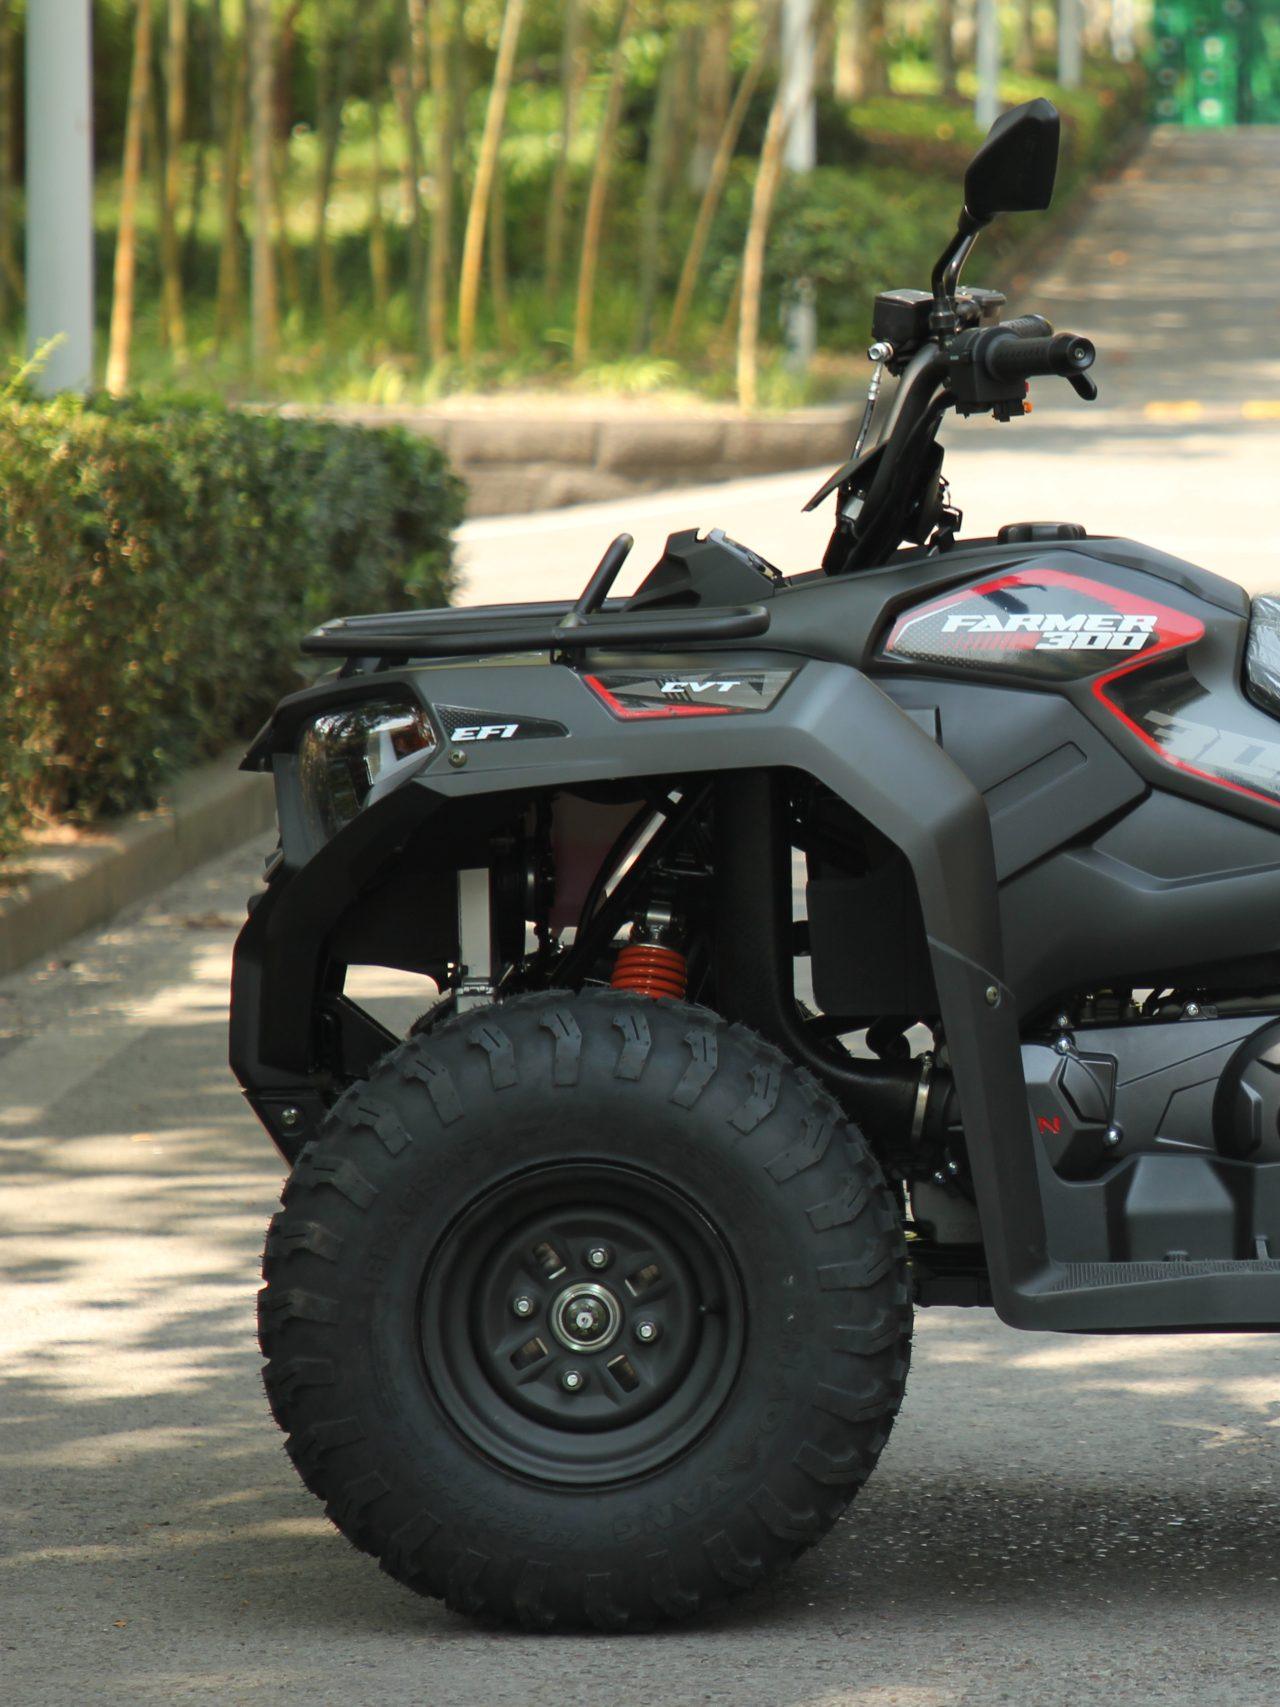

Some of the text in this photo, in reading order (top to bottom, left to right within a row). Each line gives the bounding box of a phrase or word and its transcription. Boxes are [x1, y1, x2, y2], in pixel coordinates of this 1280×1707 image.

[941, 613, 1159, 633] FARMER
[1034, 631, 1152, 650] 300
[660, 681, 741, 693] CVT
[450, 723, 519, 742] EFI
